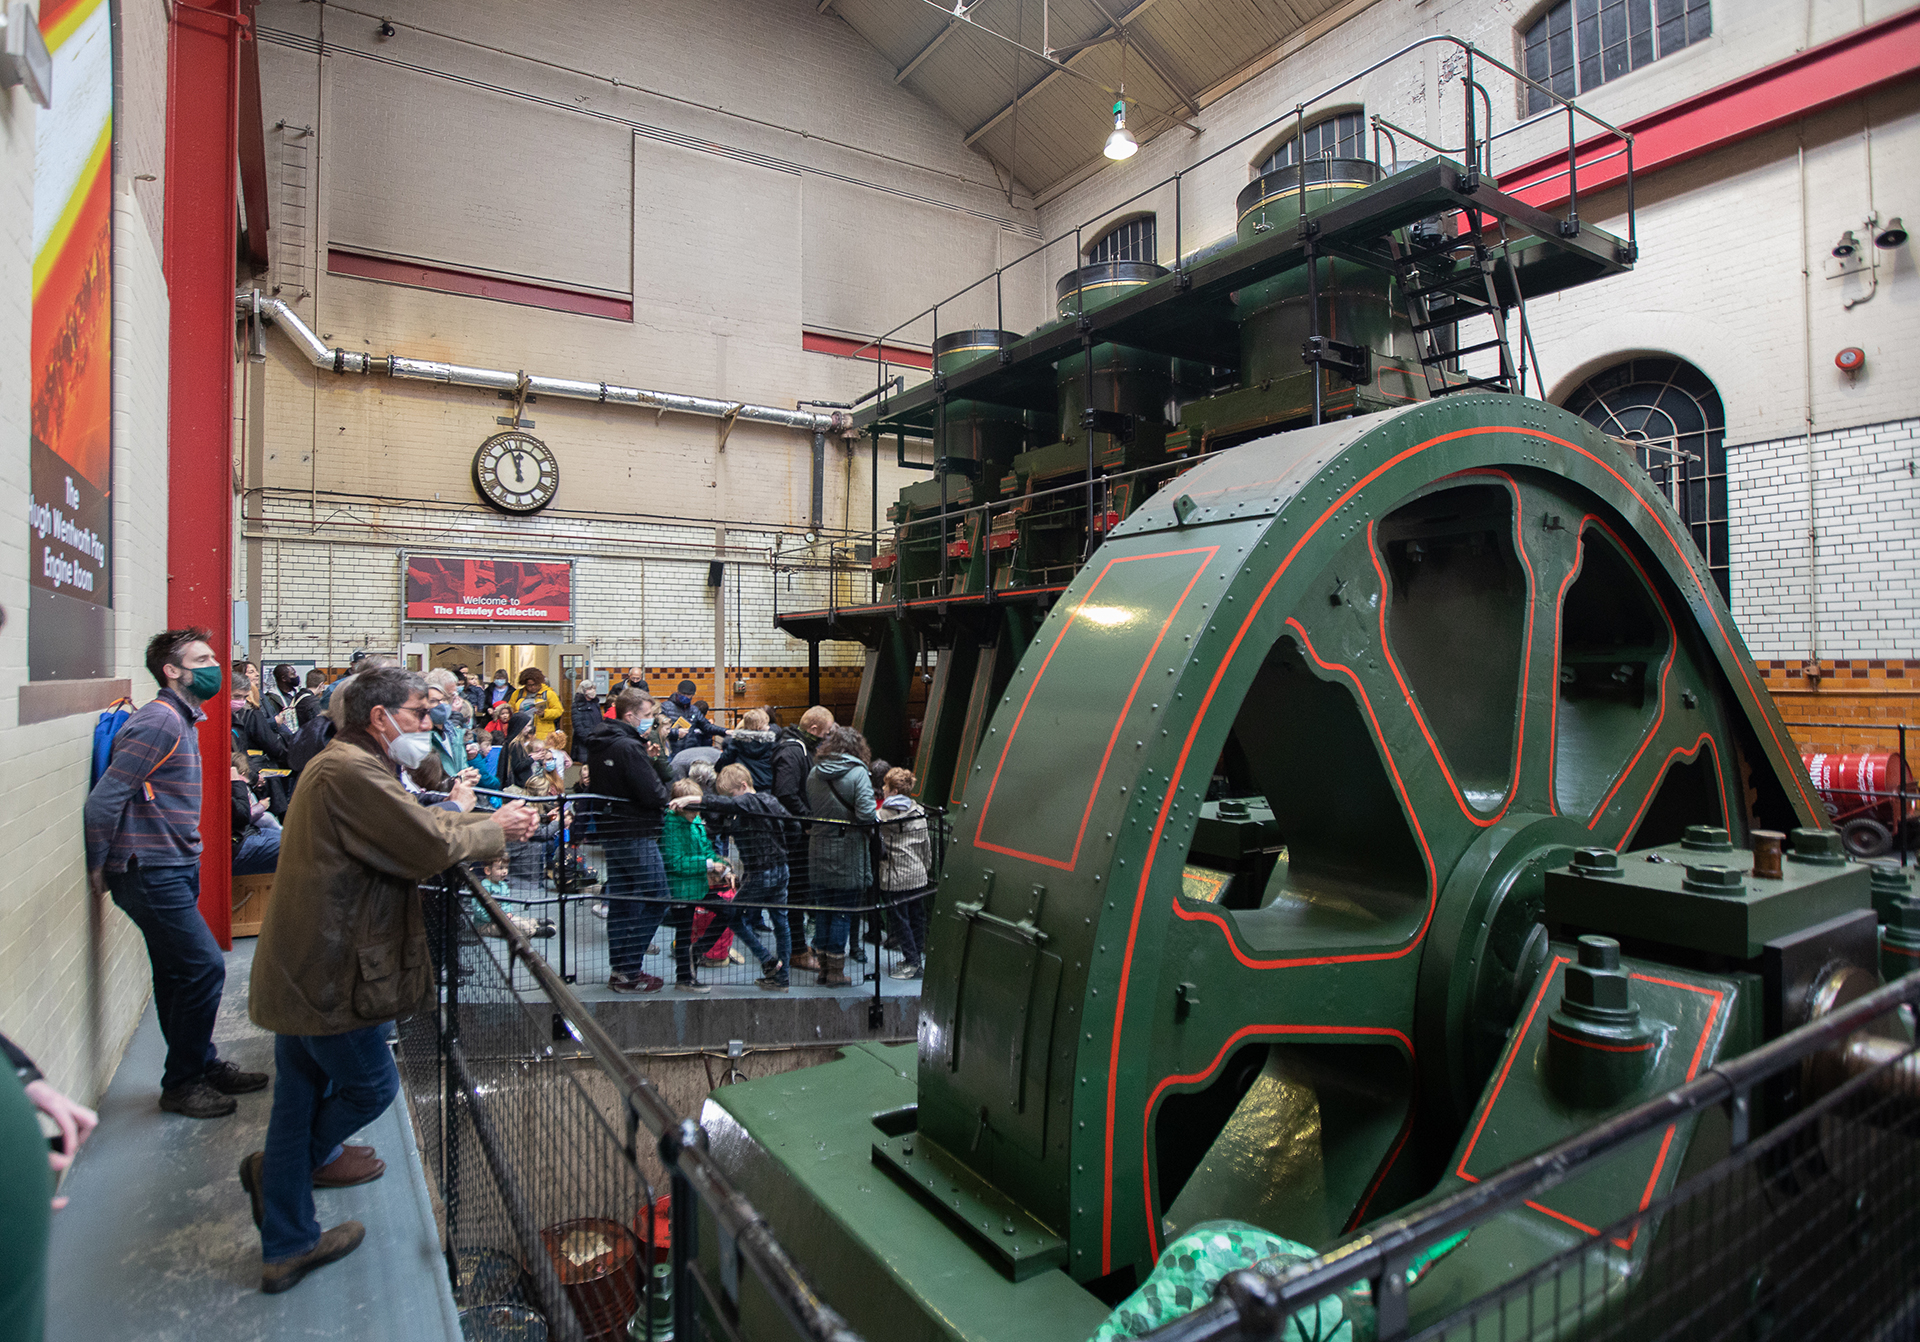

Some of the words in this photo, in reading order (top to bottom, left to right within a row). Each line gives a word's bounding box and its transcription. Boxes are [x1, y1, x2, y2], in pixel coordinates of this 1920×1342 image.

[65, 476, 80, 510] The
[53, 508, 91, 556] Wentworth
[43, 546, 73, 588] Engine
[73, 559, 94, 592] Room
[434, 605, 453, 615] The
[456, 606, 494, 618] Hawley
[496, 607, 547, 617] Collection
[463, 596, 507, 606] Welcome
[510, 598, 520, 606] to
